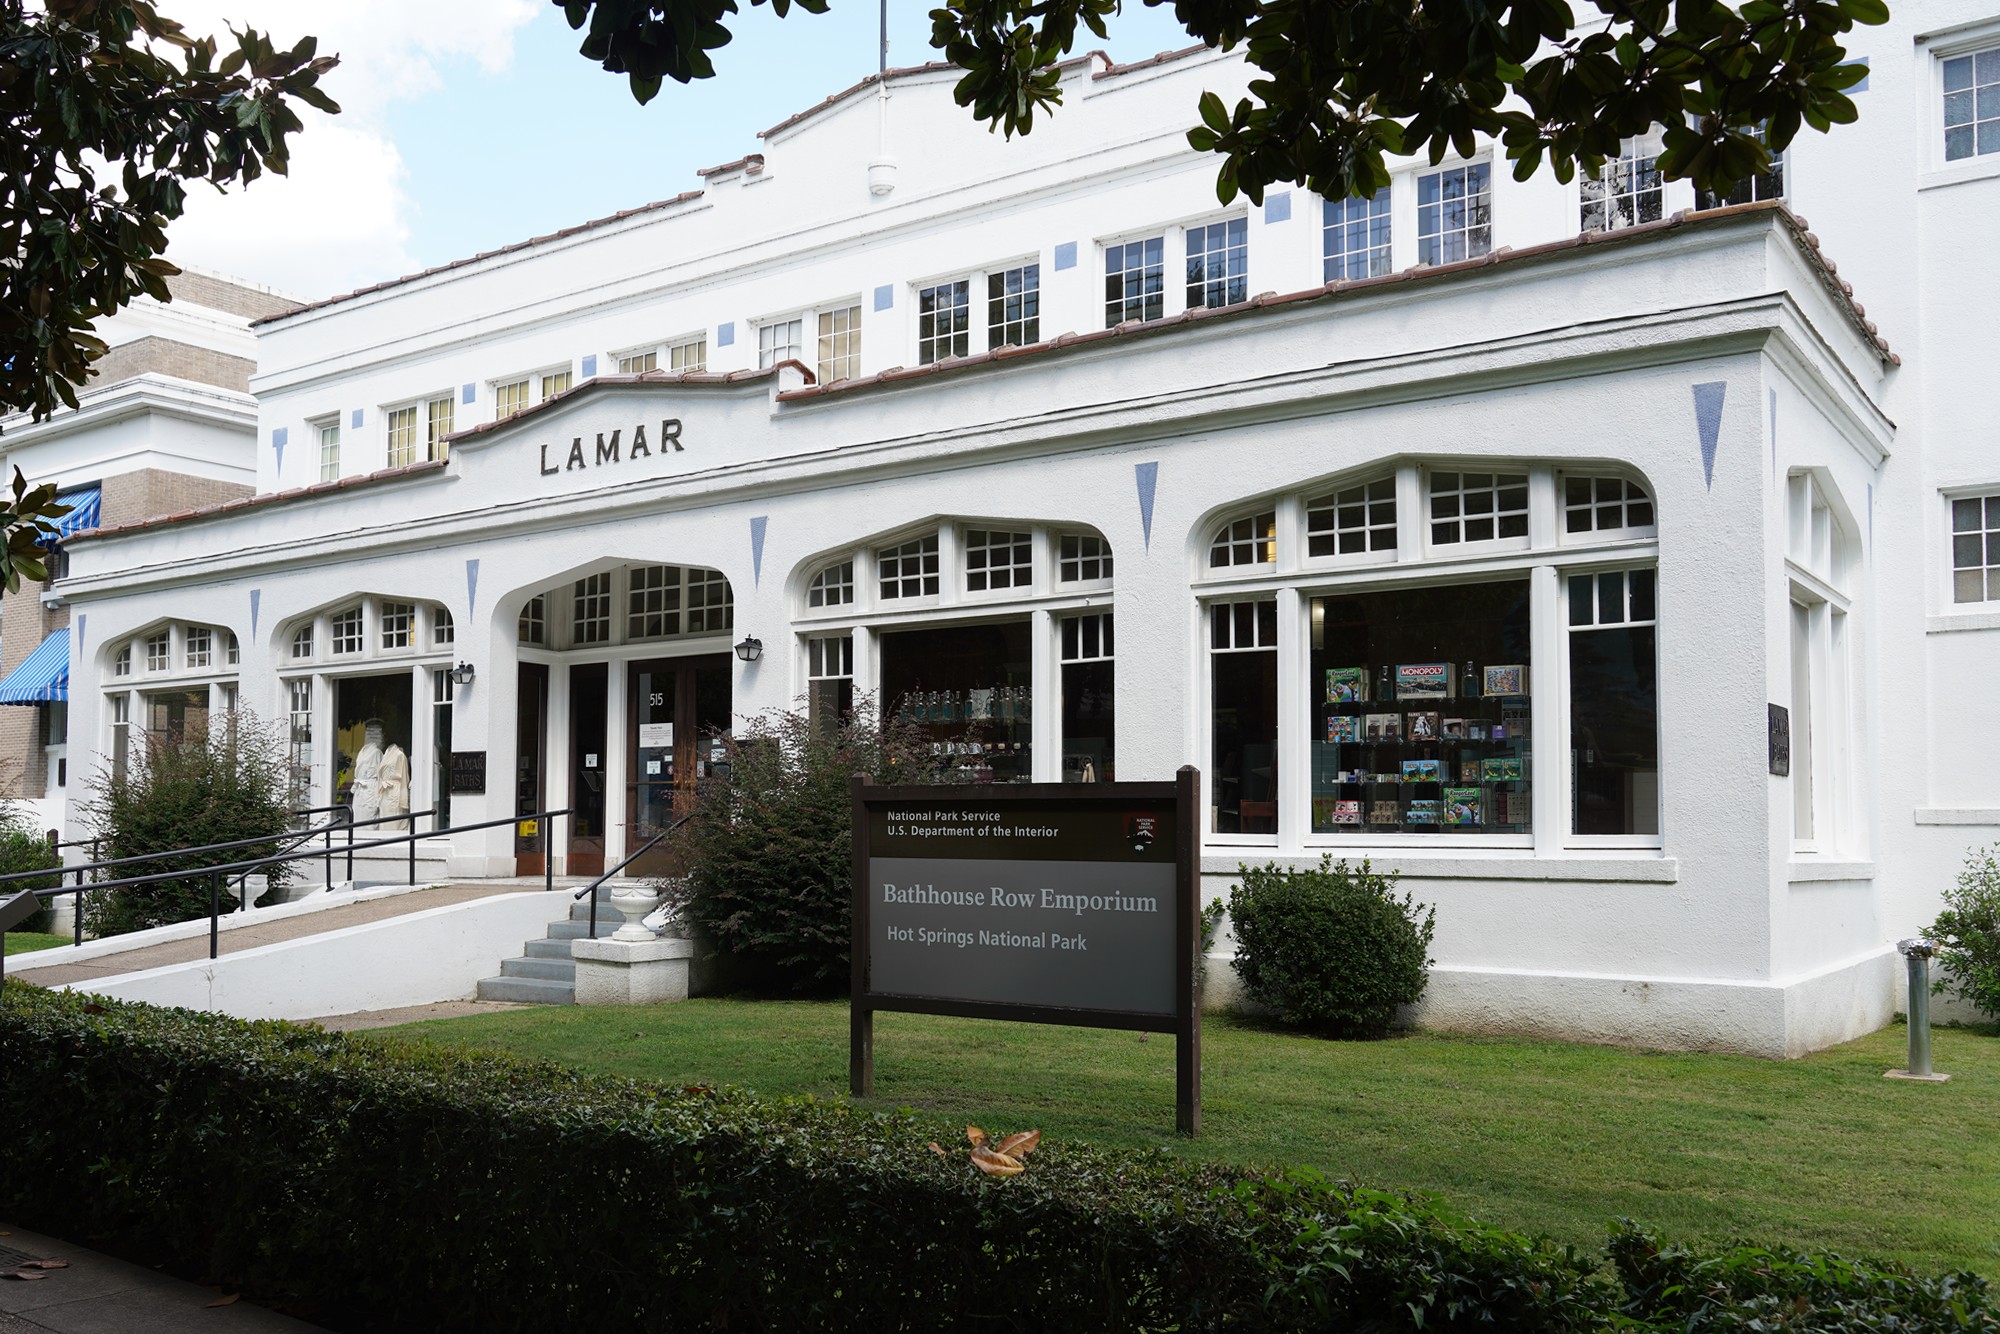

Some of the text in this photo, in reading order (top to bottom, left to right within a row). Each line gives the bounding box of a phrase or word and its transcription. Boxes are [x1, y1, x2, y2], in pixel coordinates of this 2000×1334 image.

[540, 418, 685, 476] LAMAR
[1401, 667, 1443, 676] MONOPOLY
[649, 692, 664, 706] 515
[452, 758, 484, 770] LAMAR
[454, 774, 481, 786] BATHS
[887, 811, 1000, 821] National Park Service
[887, 826, 1059, 838] U.S. Department of the Interior
[883, 883, 1158, 916] Bathhouse Row Emporium
[887, 926, 1087, 950] Hot Springs National Park
